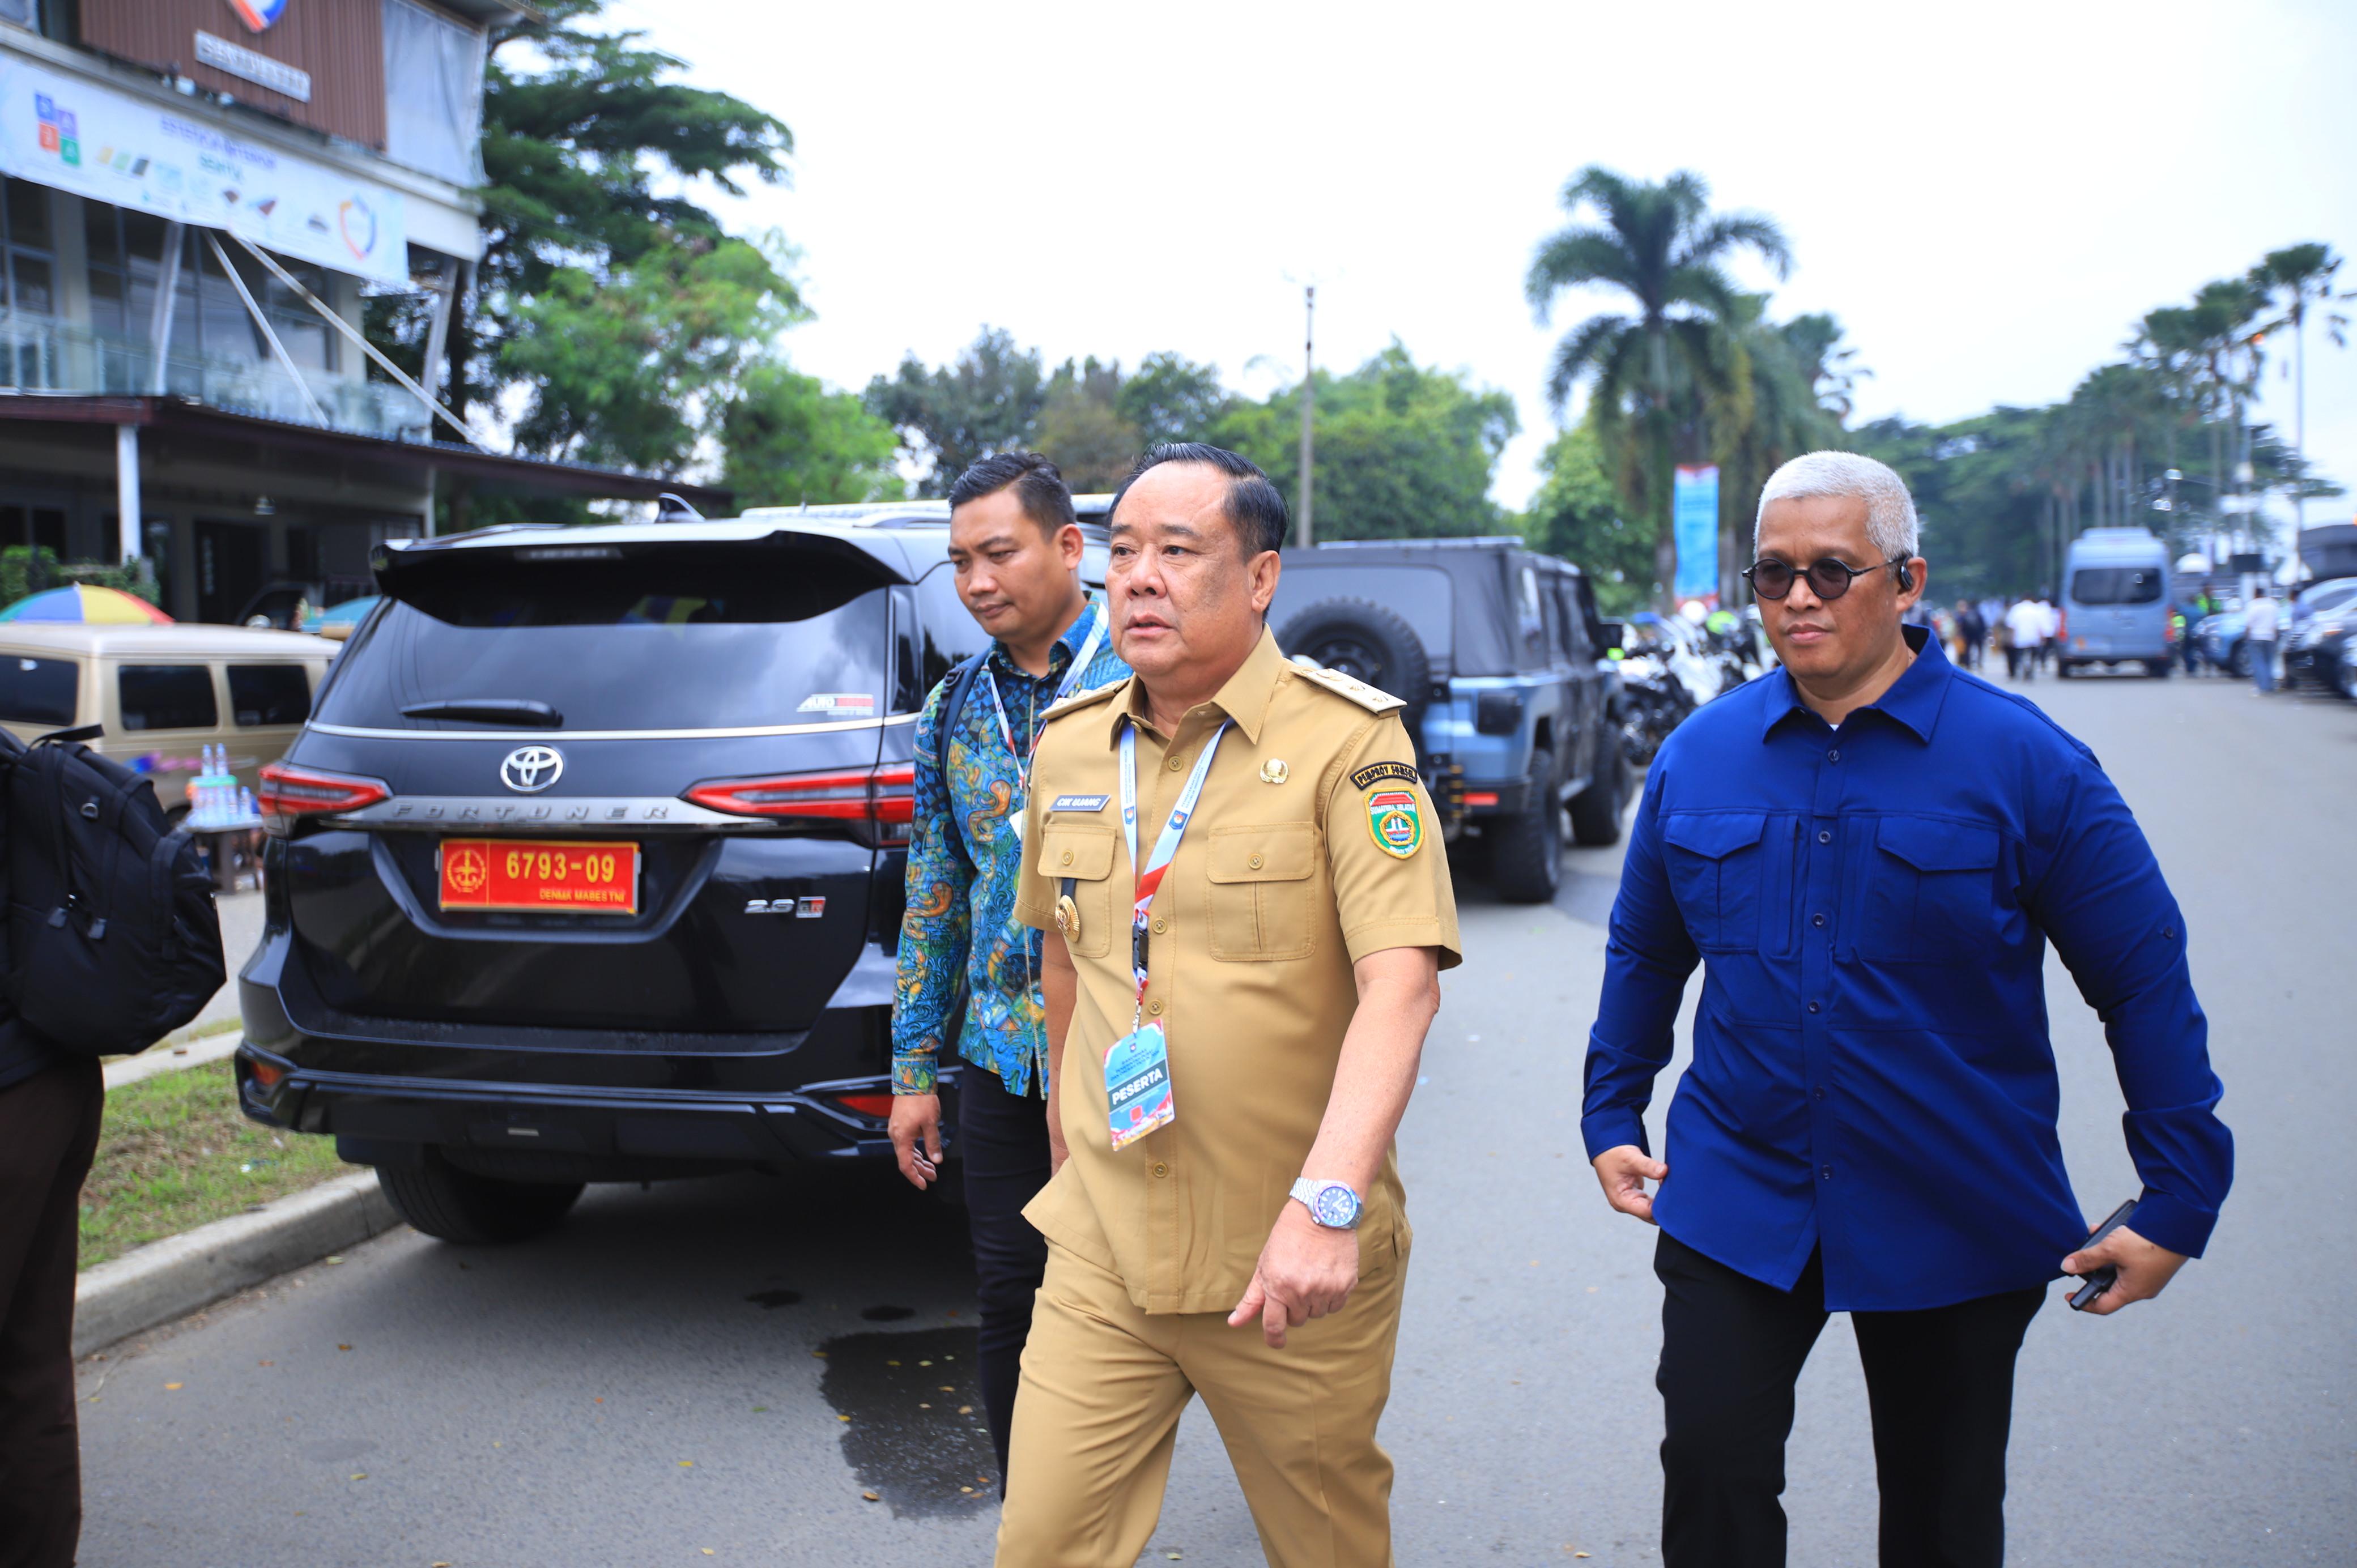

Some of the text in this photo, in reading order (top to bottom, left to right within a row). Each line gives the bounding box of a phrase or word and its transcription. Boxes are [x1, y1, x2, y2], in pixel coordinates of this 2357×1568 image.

[1057, 798, 1101, 807] CIK UJANG
[1370, 804, 1416, 815] SUMATERA SELATAN
[392, 803, 669, 821] FORTUNER
[506, 850, 615, 883] 6793-09
[539, 888, 626, 903] DENMA MABES TNI
[1112, 1068, 1163, 1105] PESERTA
